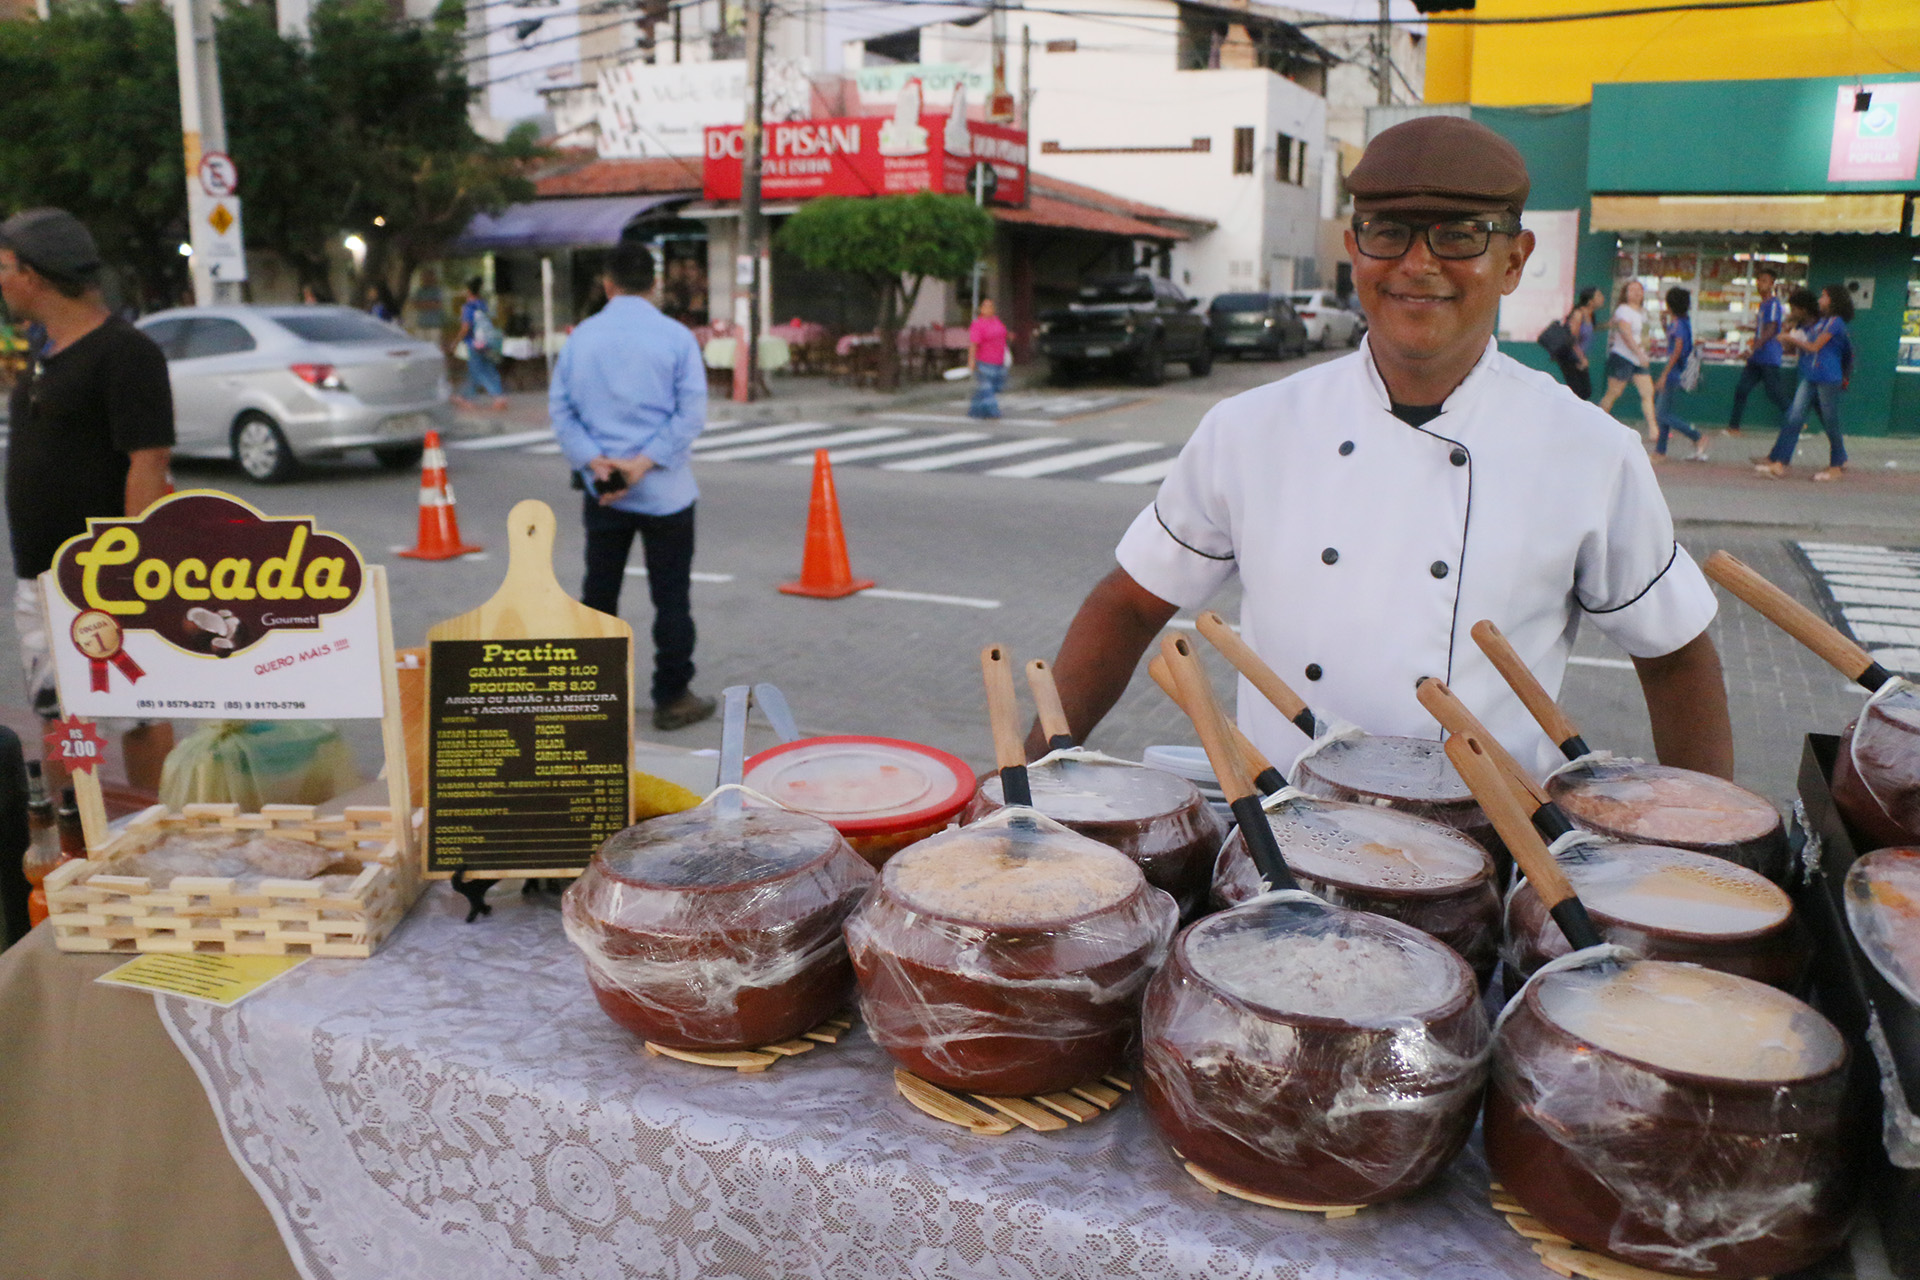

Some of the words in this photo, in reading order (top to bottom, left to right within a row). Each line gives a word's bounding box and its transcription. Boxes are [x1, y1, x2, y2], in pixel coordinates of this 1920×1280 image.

[708, 129, 769, 159] DO
[776, 124, 860, 156] PISANI
[75, 525, 351, 615] Cocada
[261, 612, 316, 626] Gourmet
[254, 655, 295, 675] QUERO
[299, 644, 331, 662] MAIS
[482, 643, 578, 662] Pratim
[136, 700, 155, 709] (85)
[445, 696, 485, 704] ARROZ
[487, 696, 504, 704] OU
[563, 693, 618, 702] MISTURA
[481, 704, 599, 714] ACOMPANHAMENTO
